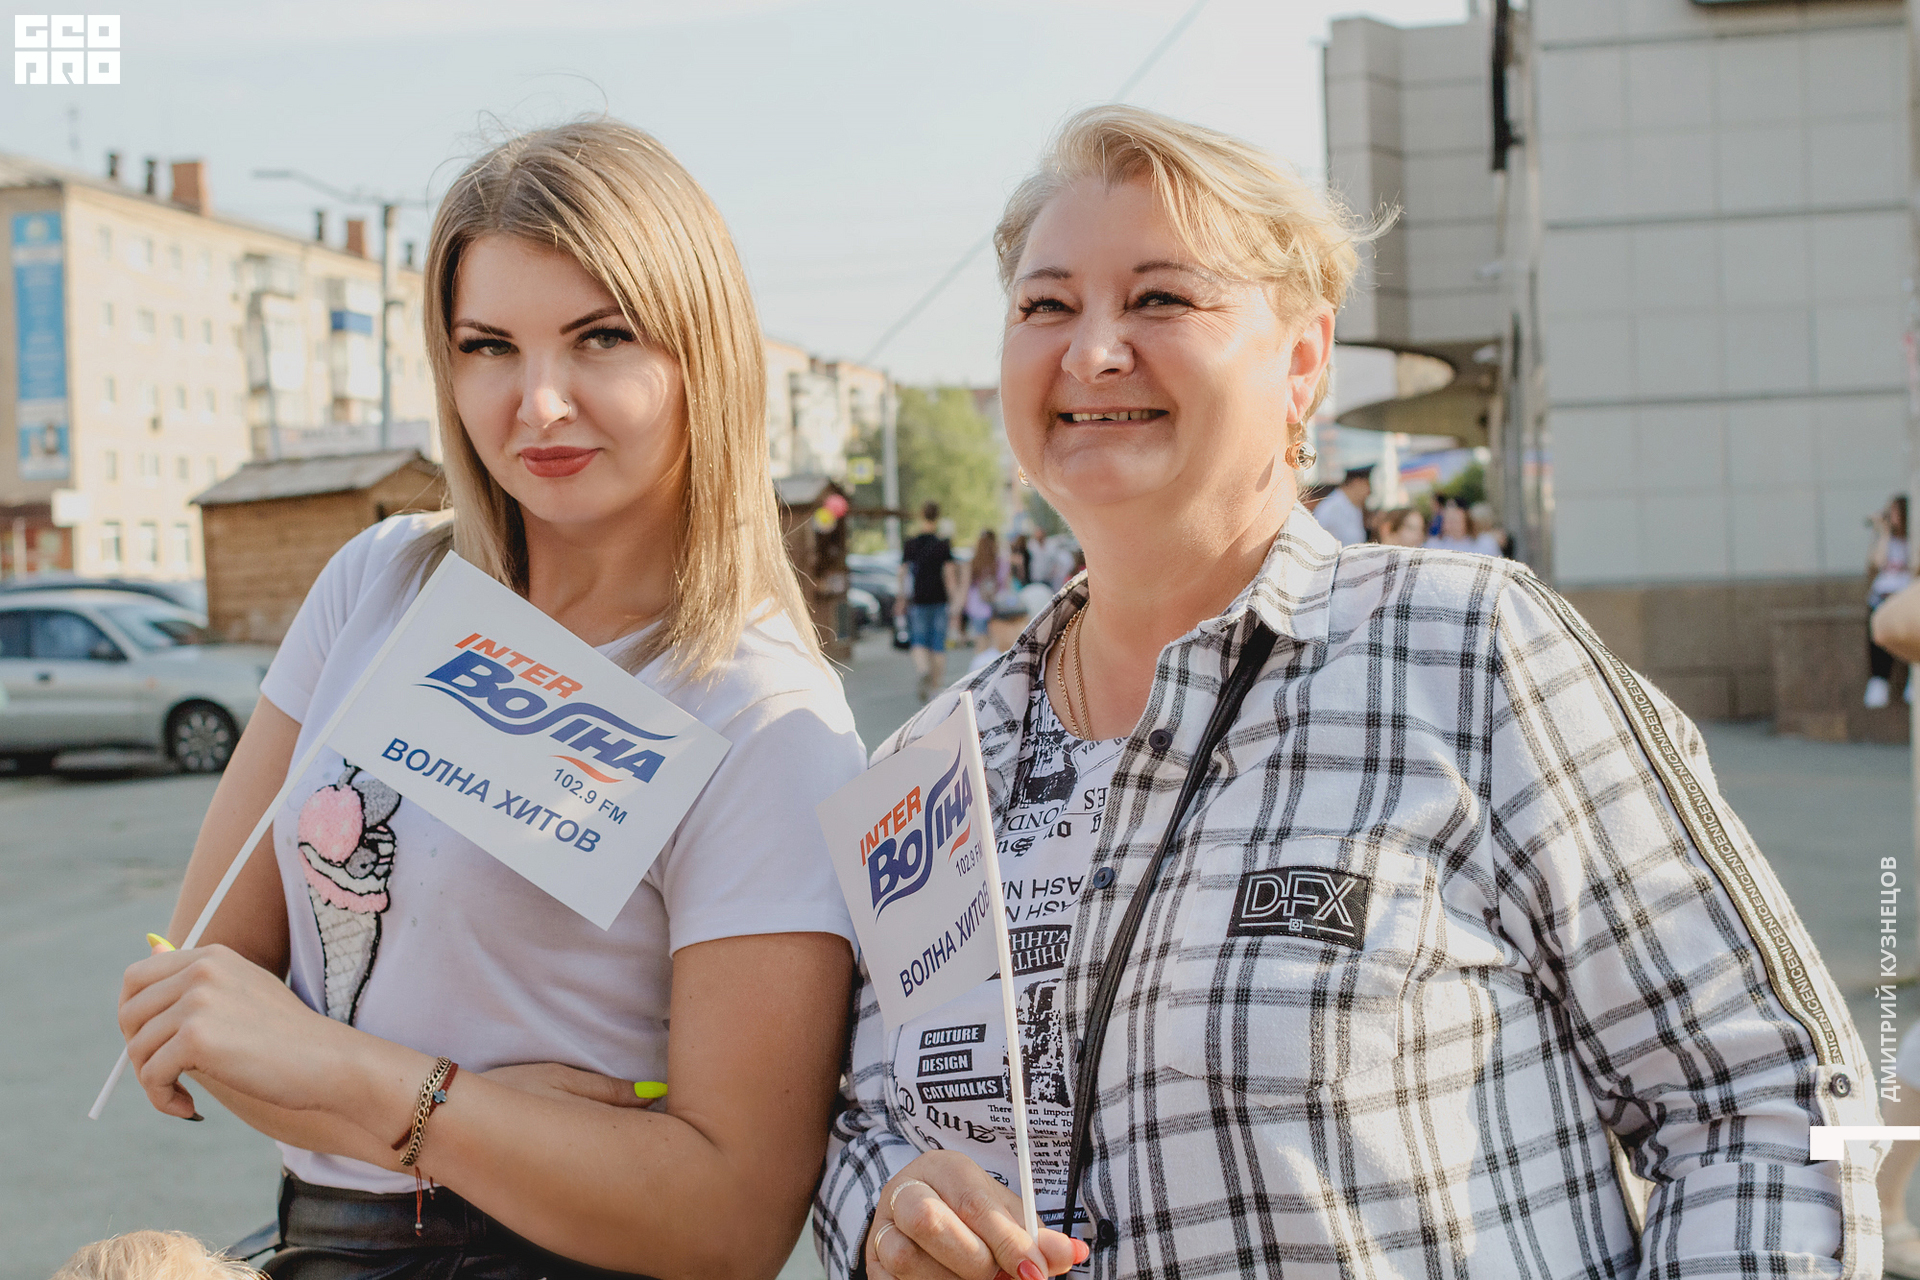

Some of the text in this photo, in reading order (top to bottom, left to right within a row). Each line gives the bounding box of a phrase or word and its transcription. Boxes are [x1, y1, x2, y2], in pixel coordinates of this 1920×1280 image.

[454, 632, 584, 699] INTER
[381, 737, 602, 854] ВОЛНА ХИТОВ
[553, 767, 628, 825] 102.9 FM
[859, 785, 922, 867] INTER
[955, 850, 975, 878] 102.9
[1242, 871, 1358, 927] DFX
[900, 880, 992, 998] ВОЛНА ХИТОВ
[922, 1053, 969, 1073] DESIGN
[924, 1027, 979, 1047] CULTURE
[922, 1080, 999, 1100] CATWALKS
[988, 1105, 1012, 1113] There
